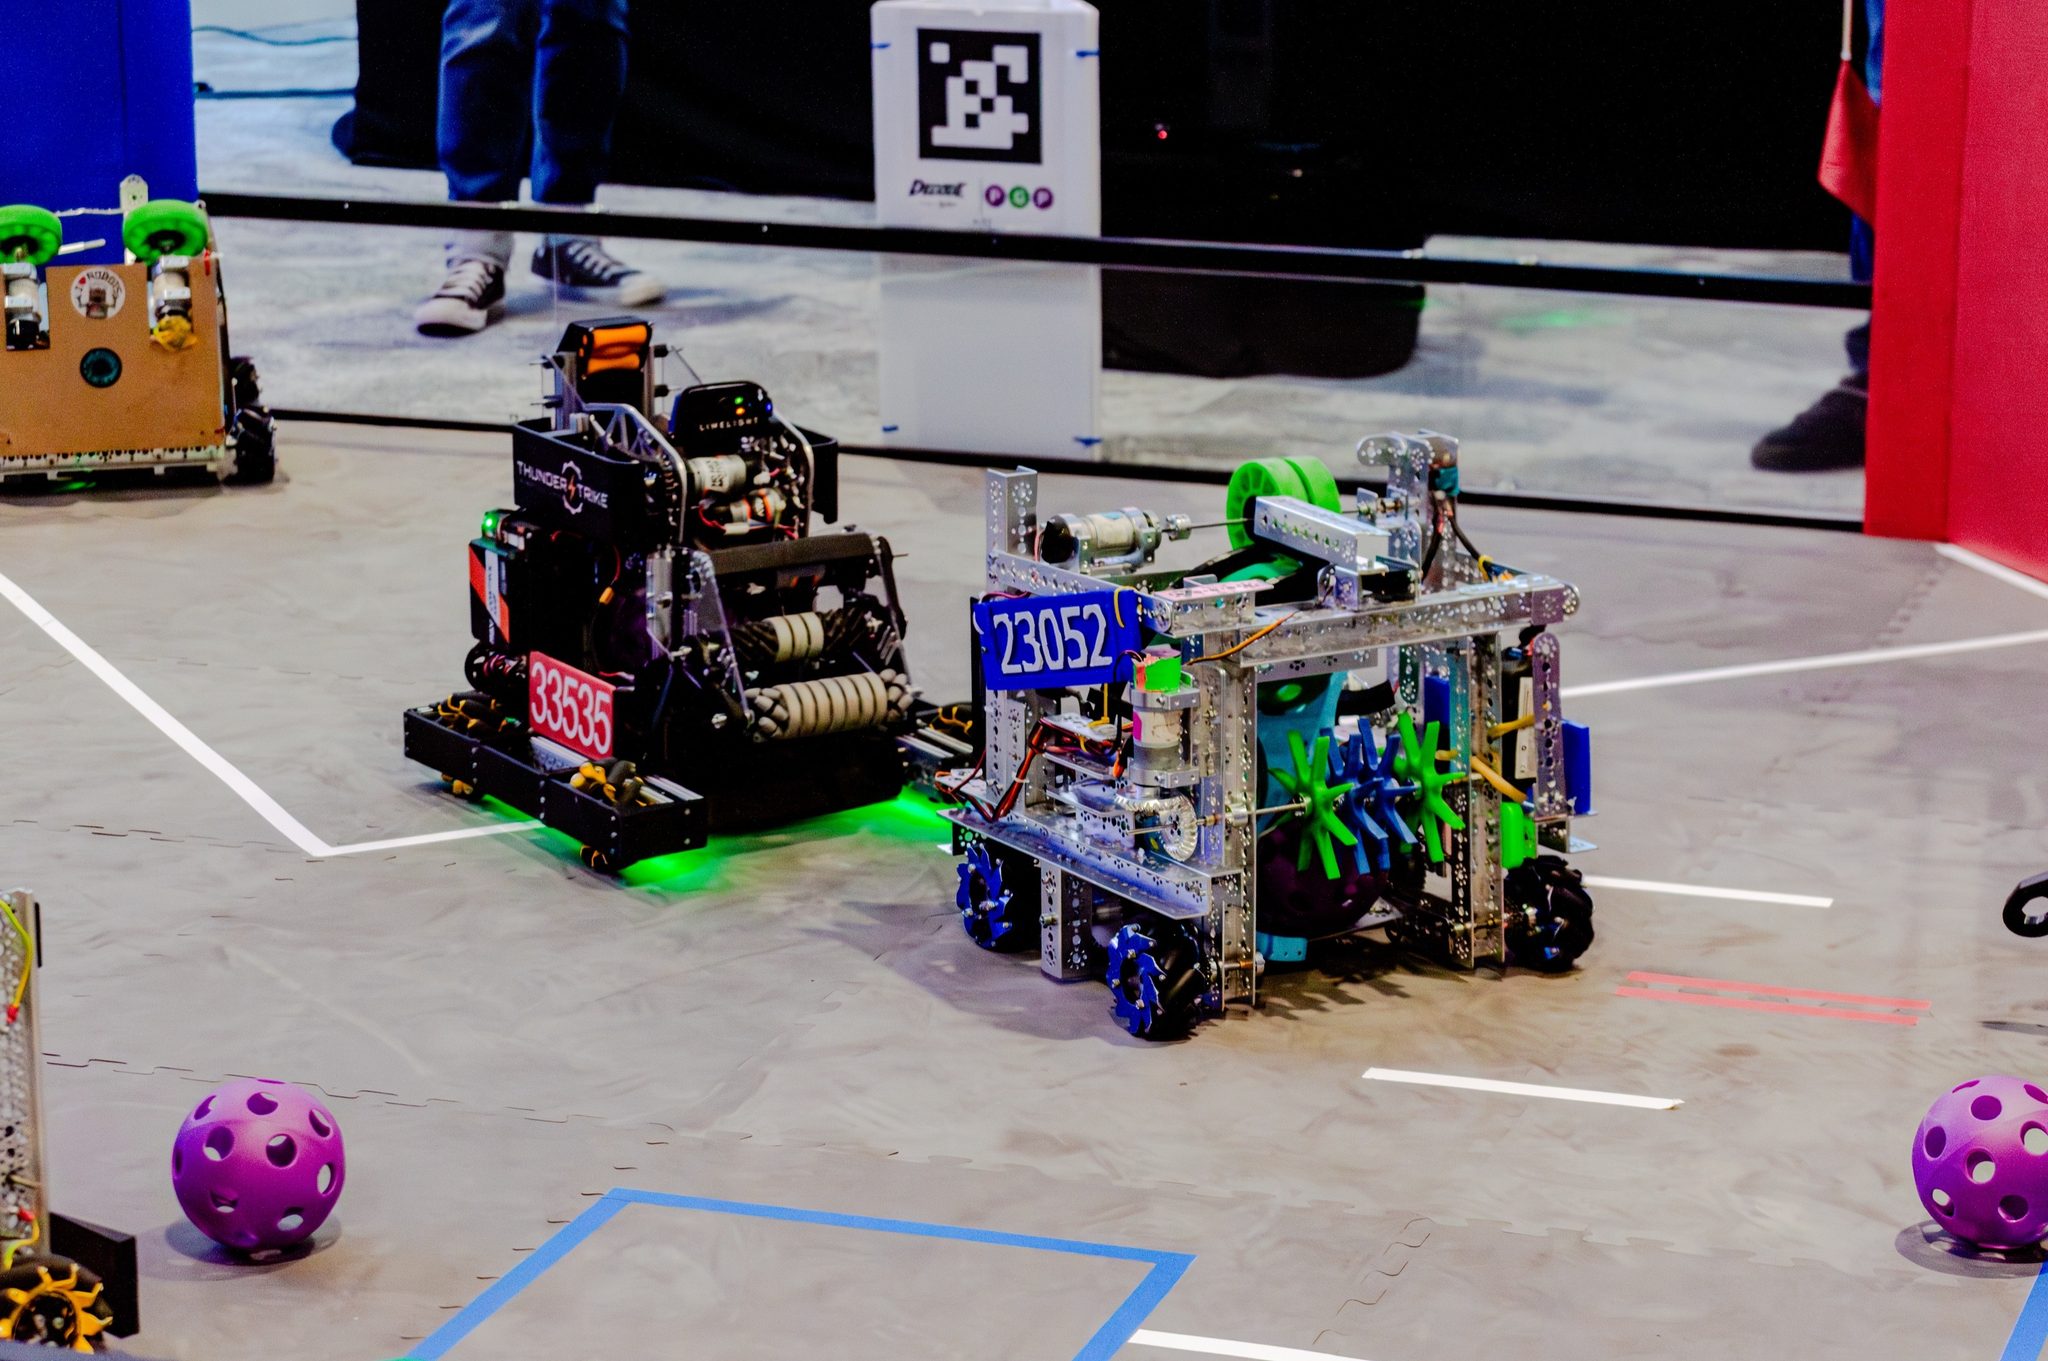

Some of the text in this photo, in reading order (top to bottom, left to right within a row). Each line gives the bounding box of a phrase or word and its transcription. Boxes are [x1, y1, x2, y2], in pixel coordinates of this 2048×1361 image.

[699, 416, 758, 431] LIMELIGHT
[993, 603, 1113, 674] 23052
[531, 661, 612, 754] 33535
